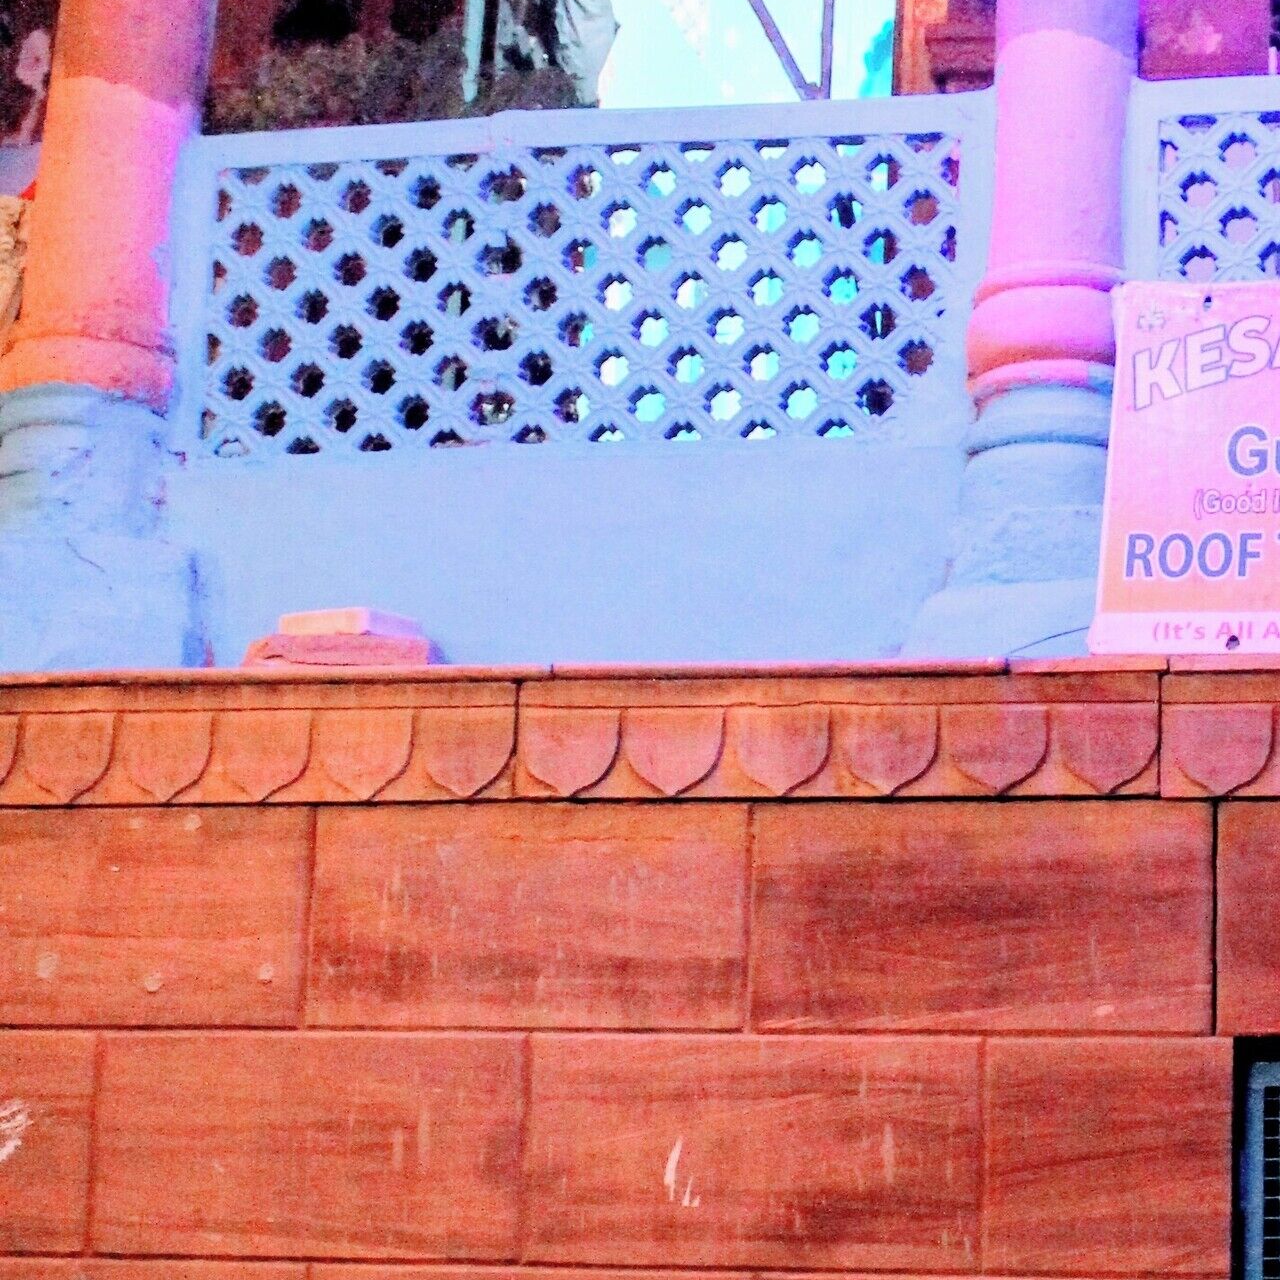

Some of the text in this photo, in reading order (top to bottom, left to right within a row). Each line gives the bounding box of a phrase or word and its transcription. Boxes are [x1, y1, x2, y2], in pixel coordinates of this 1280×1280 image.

[1194, 488, 1266, 520] (Good
[1125, 531, 1263, 578] ROOF
[1215, 621, 1254, 640] All
